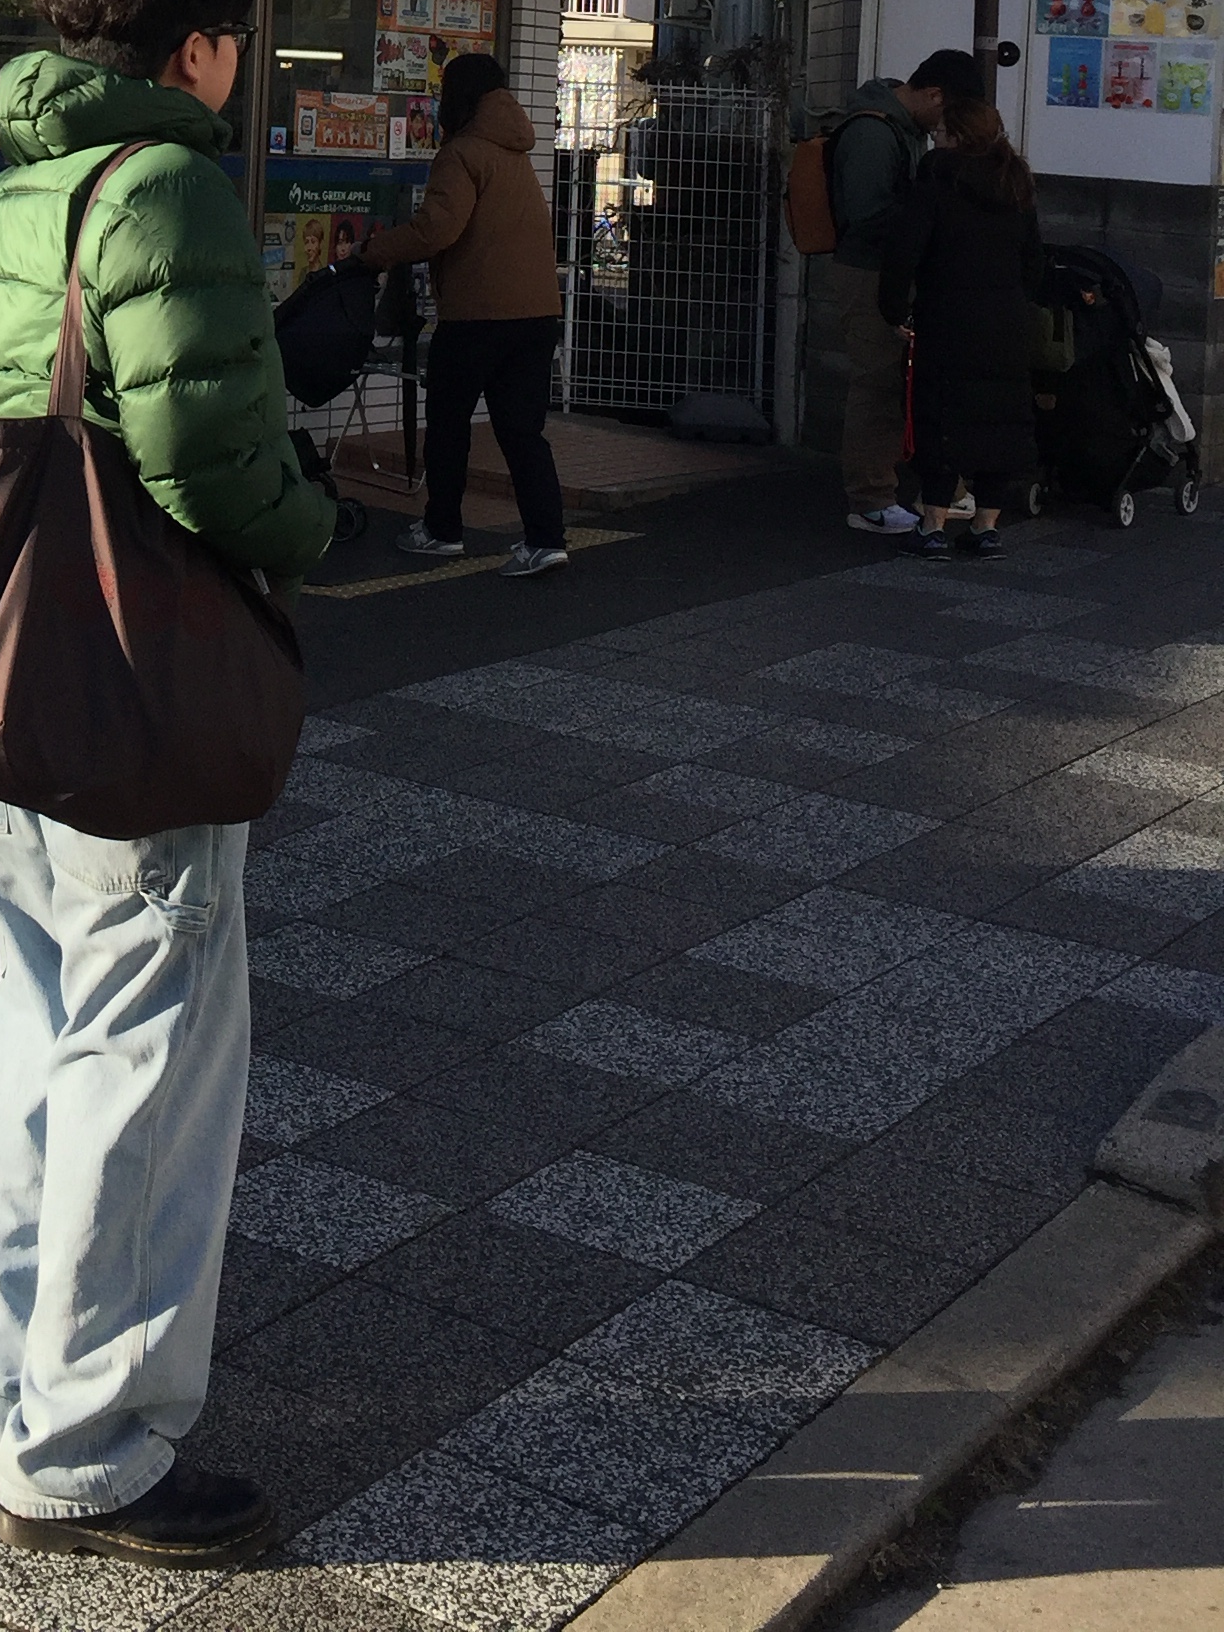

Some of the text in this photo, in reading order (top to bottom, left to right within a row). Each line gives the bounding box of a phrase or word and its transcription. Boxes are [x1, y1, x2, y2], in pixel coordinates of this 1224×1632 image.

[303, 190, 372, 202] Mrs. GREEN APPLE
